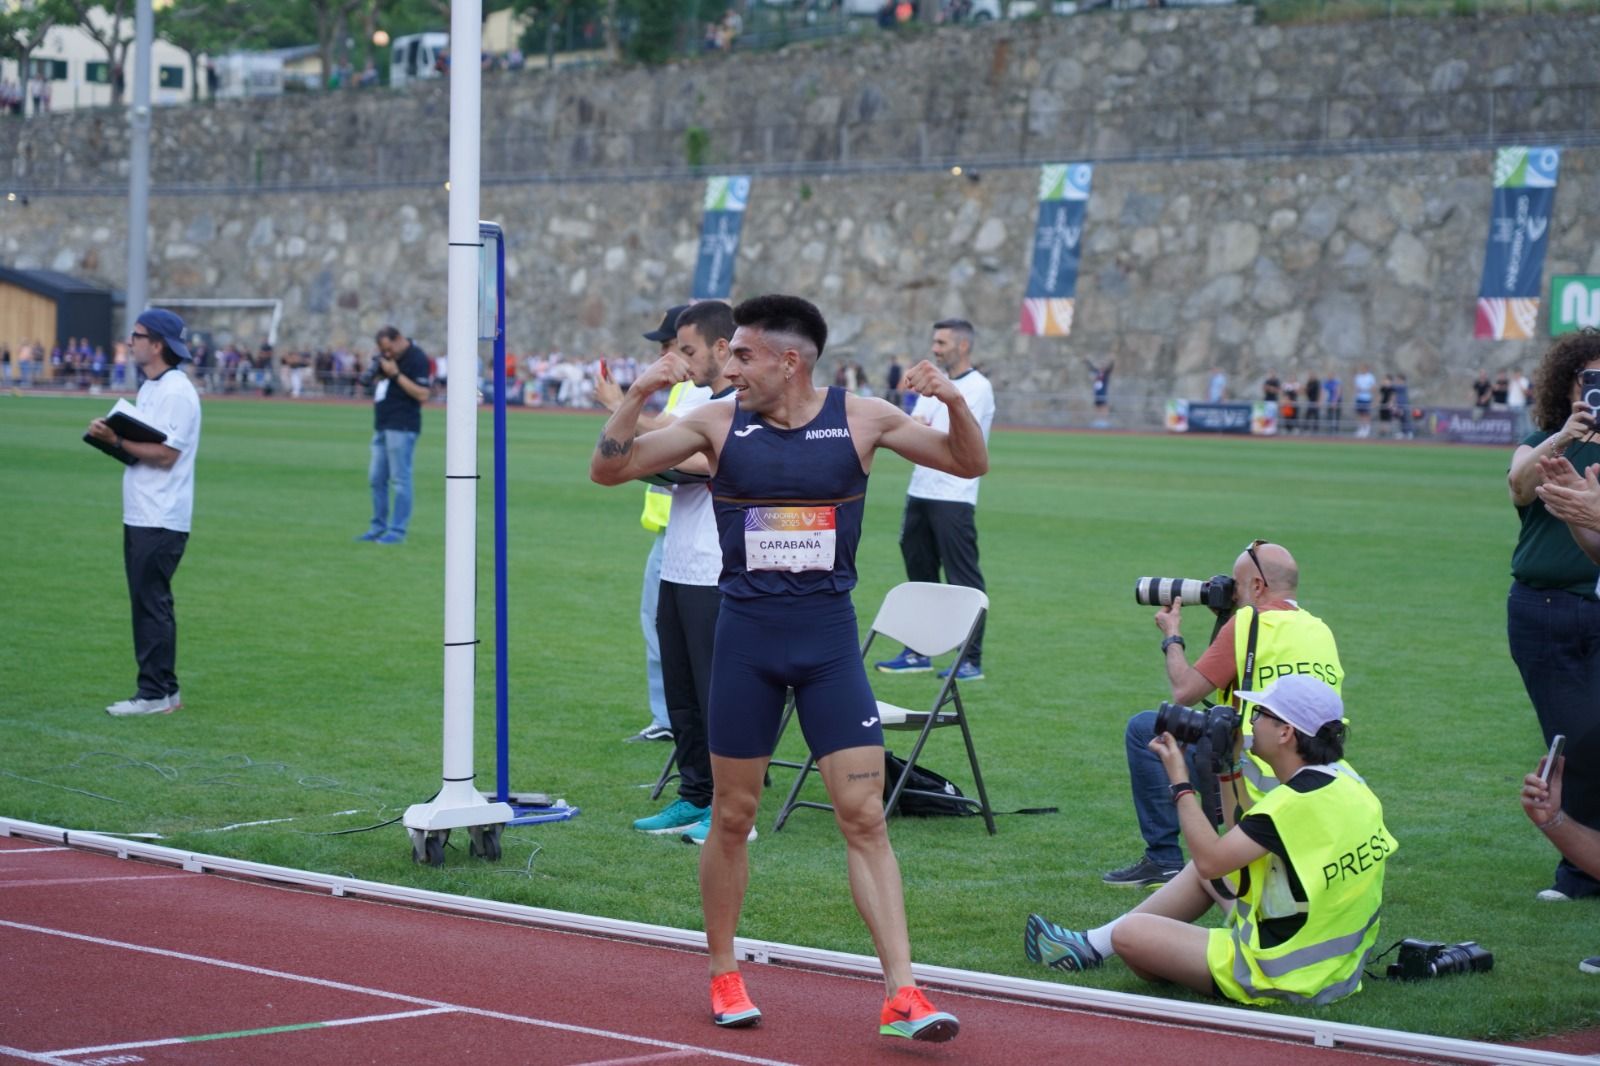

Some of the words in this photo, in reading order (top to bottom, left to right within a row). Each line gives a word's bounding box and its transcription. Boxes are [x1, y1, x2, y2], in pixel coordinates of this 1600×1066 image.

[805, 428, 850, 440] ANDORRA
[763, 512, 800, 520] ANDORRA
[760, 538, 821, 550] CARABAÑA
